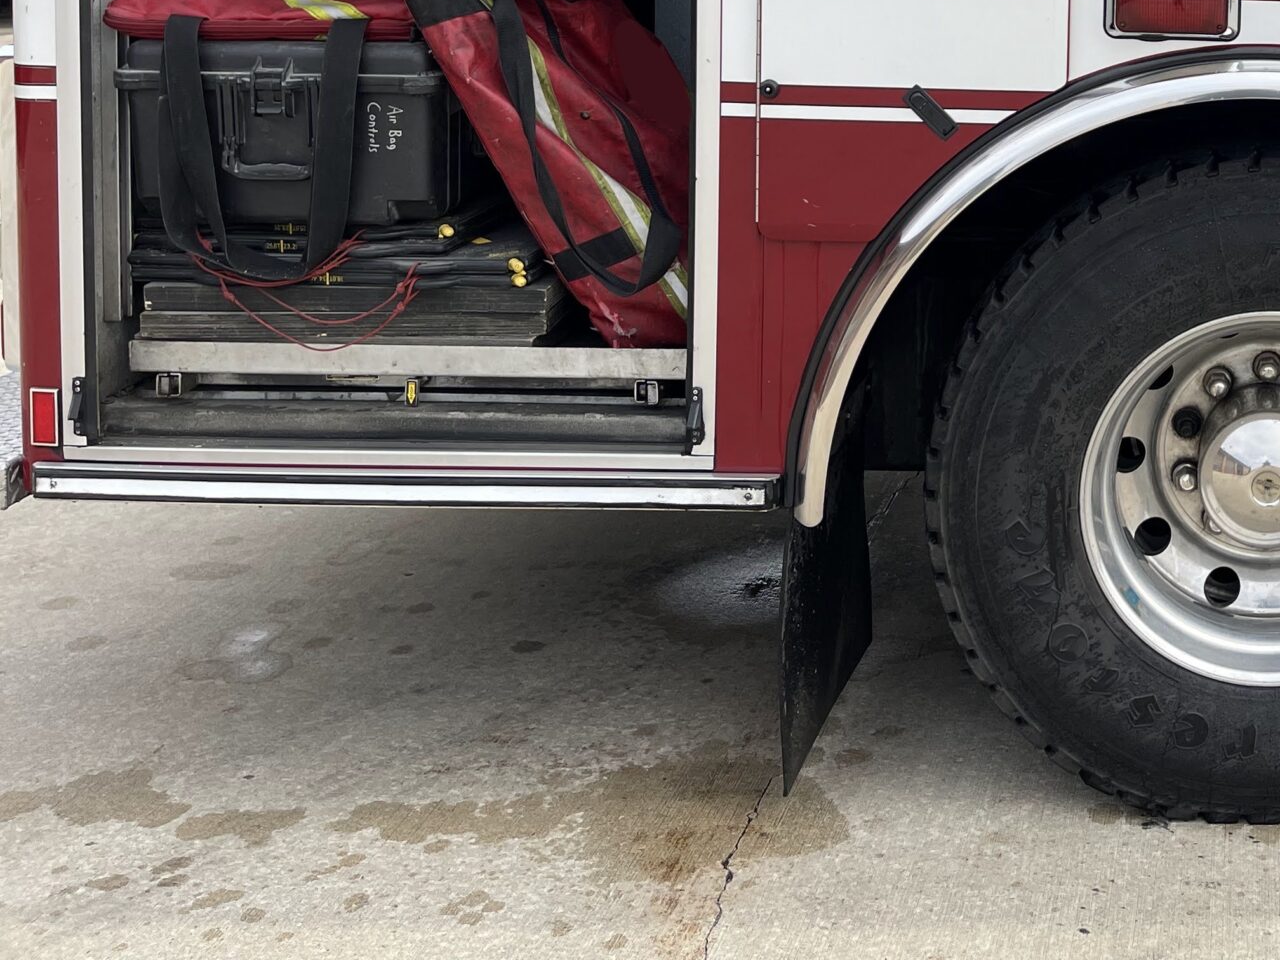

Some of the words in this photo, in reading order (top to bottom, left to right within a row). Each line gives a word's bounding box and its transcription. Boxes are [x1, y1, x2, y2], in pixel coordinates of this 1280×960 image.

[386, 104, 404, 124] Air
[366, 101, 382, 153] Controls
[386, 130, 403, 150] Bag
